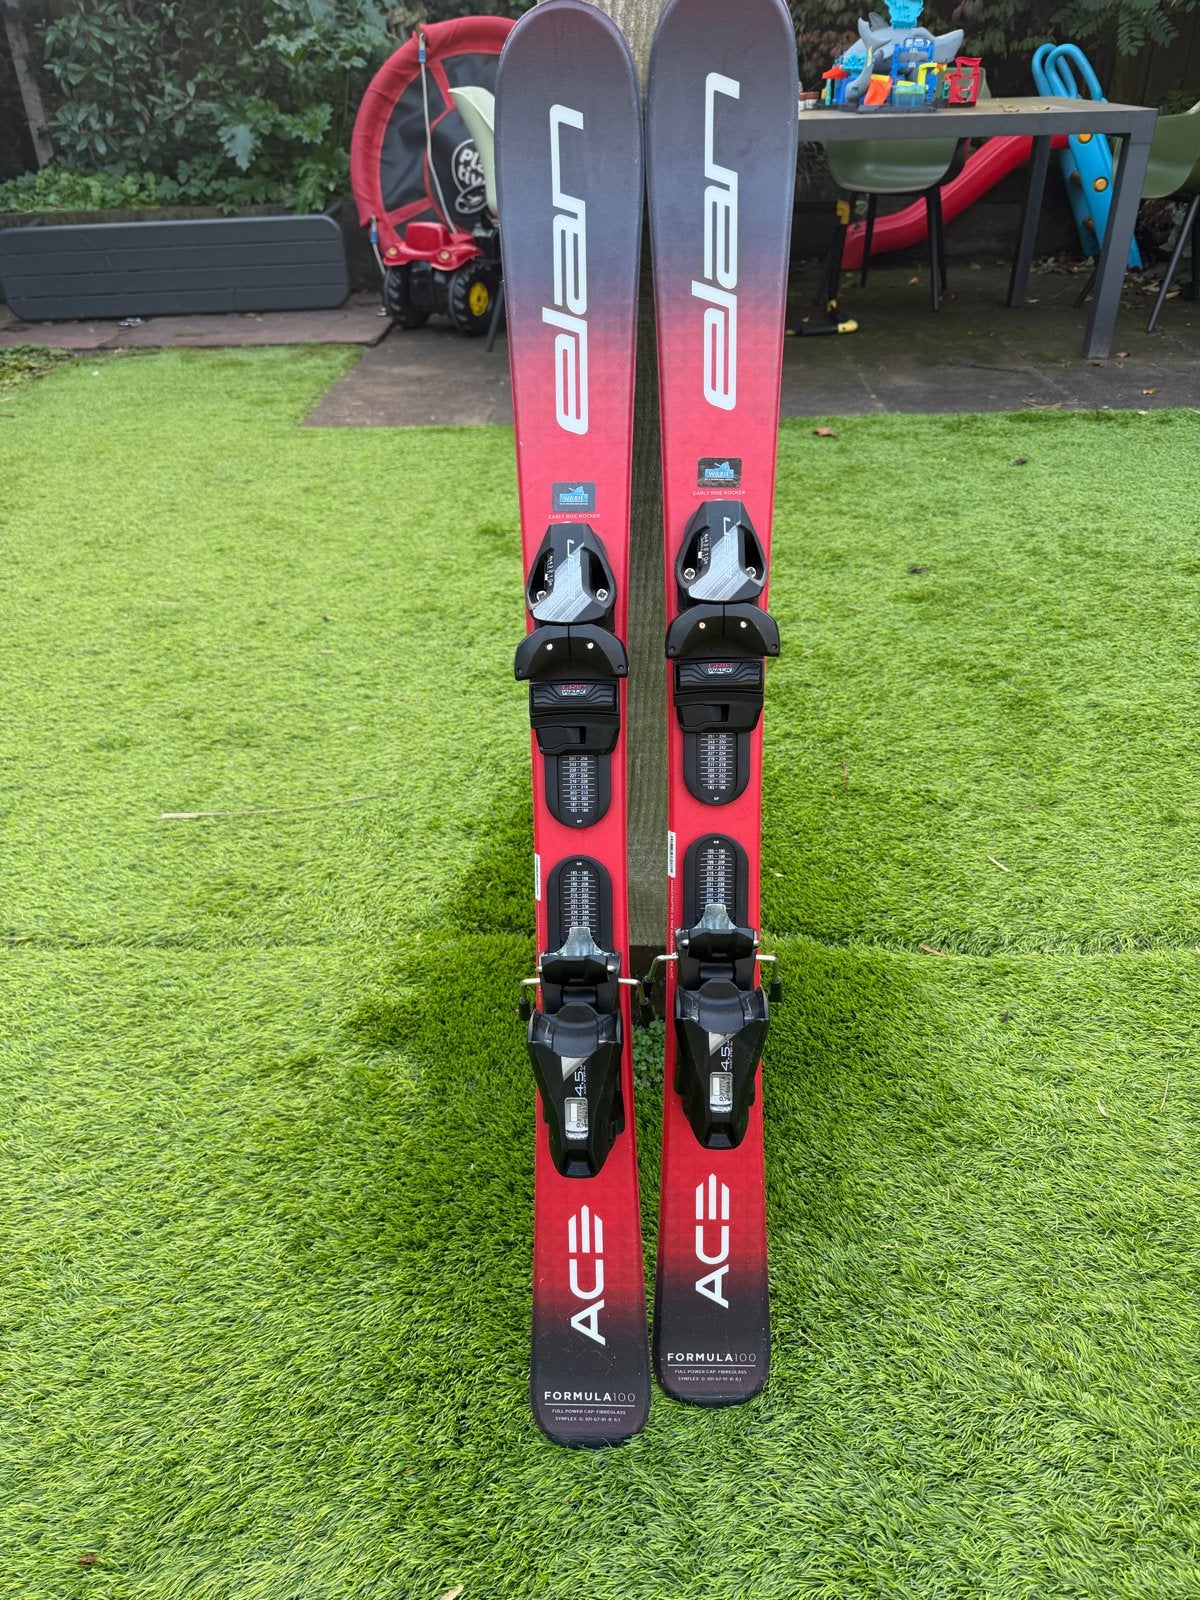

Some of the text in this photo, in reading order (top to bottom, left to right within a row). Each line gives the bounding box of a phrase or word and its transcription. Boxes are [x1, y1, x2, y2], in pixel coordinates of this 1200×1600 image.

[542, 104, 589, 435] elan
[692, 72, 740, 411] elan
[574, 1071, 584, 1096] 4.5
[721, 1047, 730, 1071] 4.5
[568, 1204, 606, 1346] ACE
[695, 1173, 730, 1309] ACE
